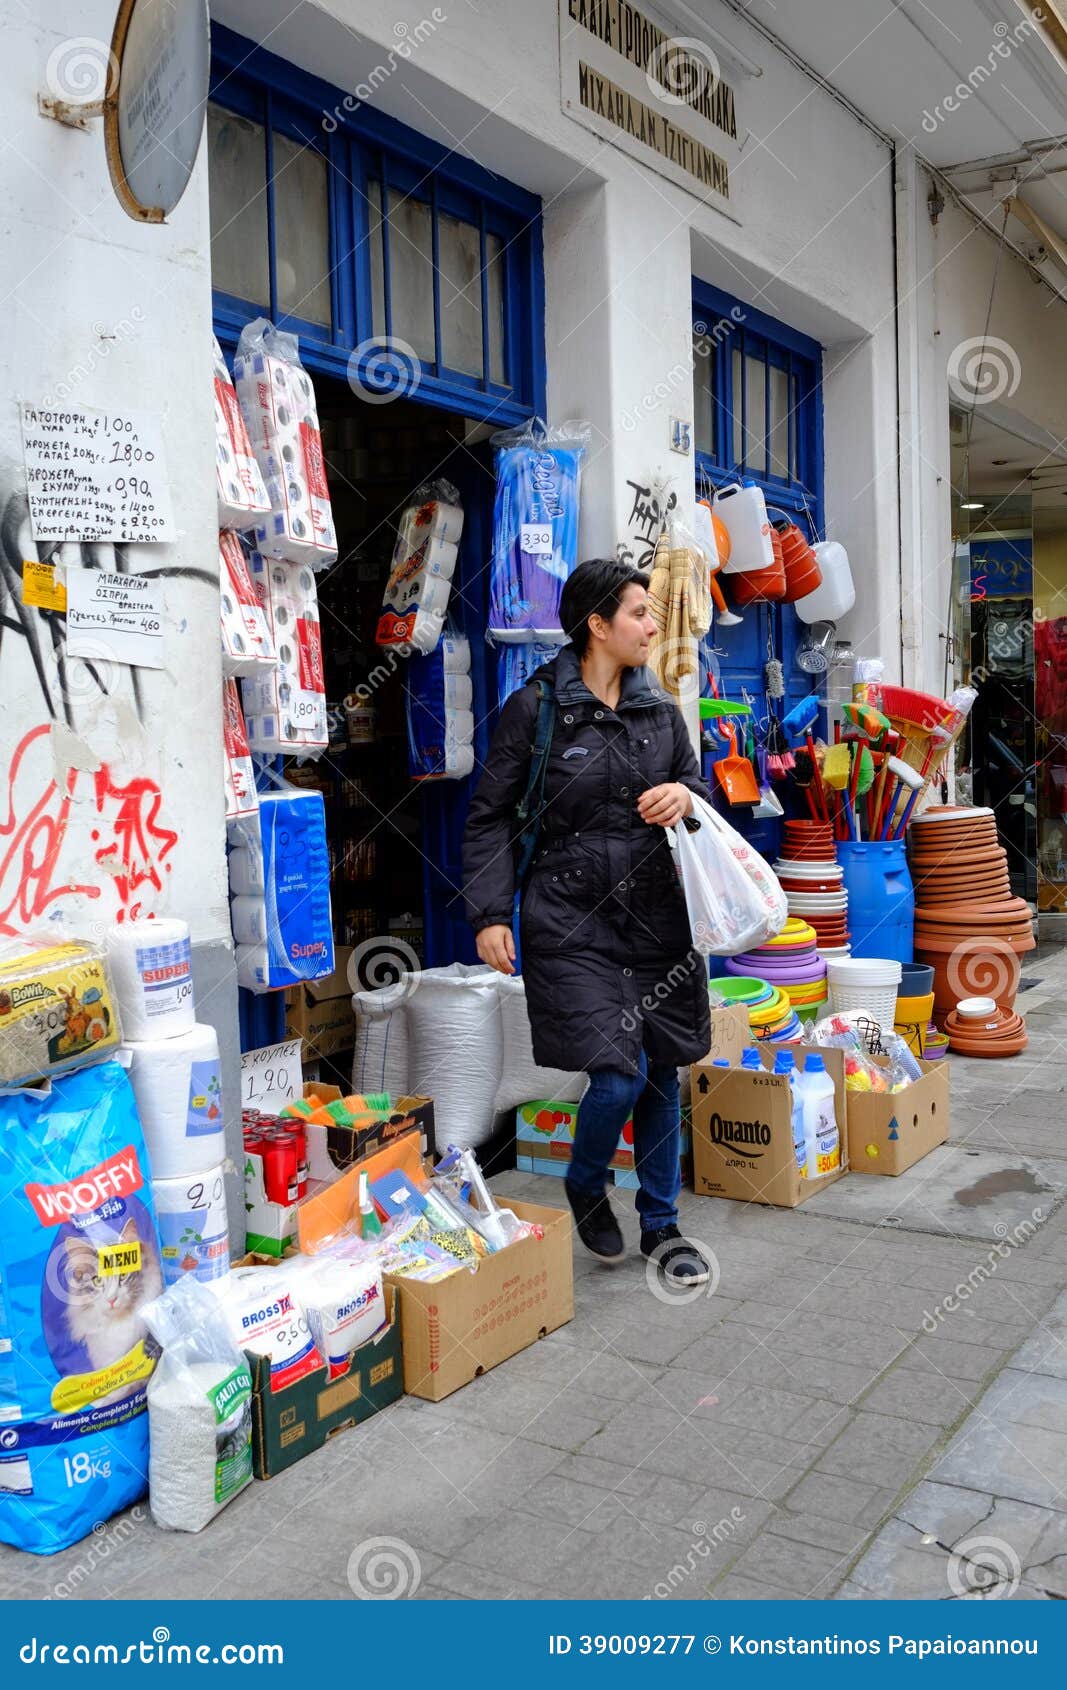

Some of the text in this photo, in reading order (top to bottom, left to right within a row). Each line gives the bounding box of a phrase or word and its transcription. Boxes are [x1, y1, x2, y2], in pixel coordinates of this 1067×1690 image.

[25, 410, 86, 424] ΓΑΤΟΤΡΟΦΗ
[523, 533, 550, 549] 3,30
[293, 703, 313, 718] 1,80
[290, 941, 324, 959] Super
[143, 962, 191, 983] SUPER
[710, 1112, 771, 1147] Quanto
[37, 1159, 136, 1218] WOOFFY
[103, 1248, 138, 1269] MENU
[242, 1297, 291, 1328] BROSSTA
[51, 1414, 90, 1431] Alimento
[92, 1402, 128, 1420] Completo
